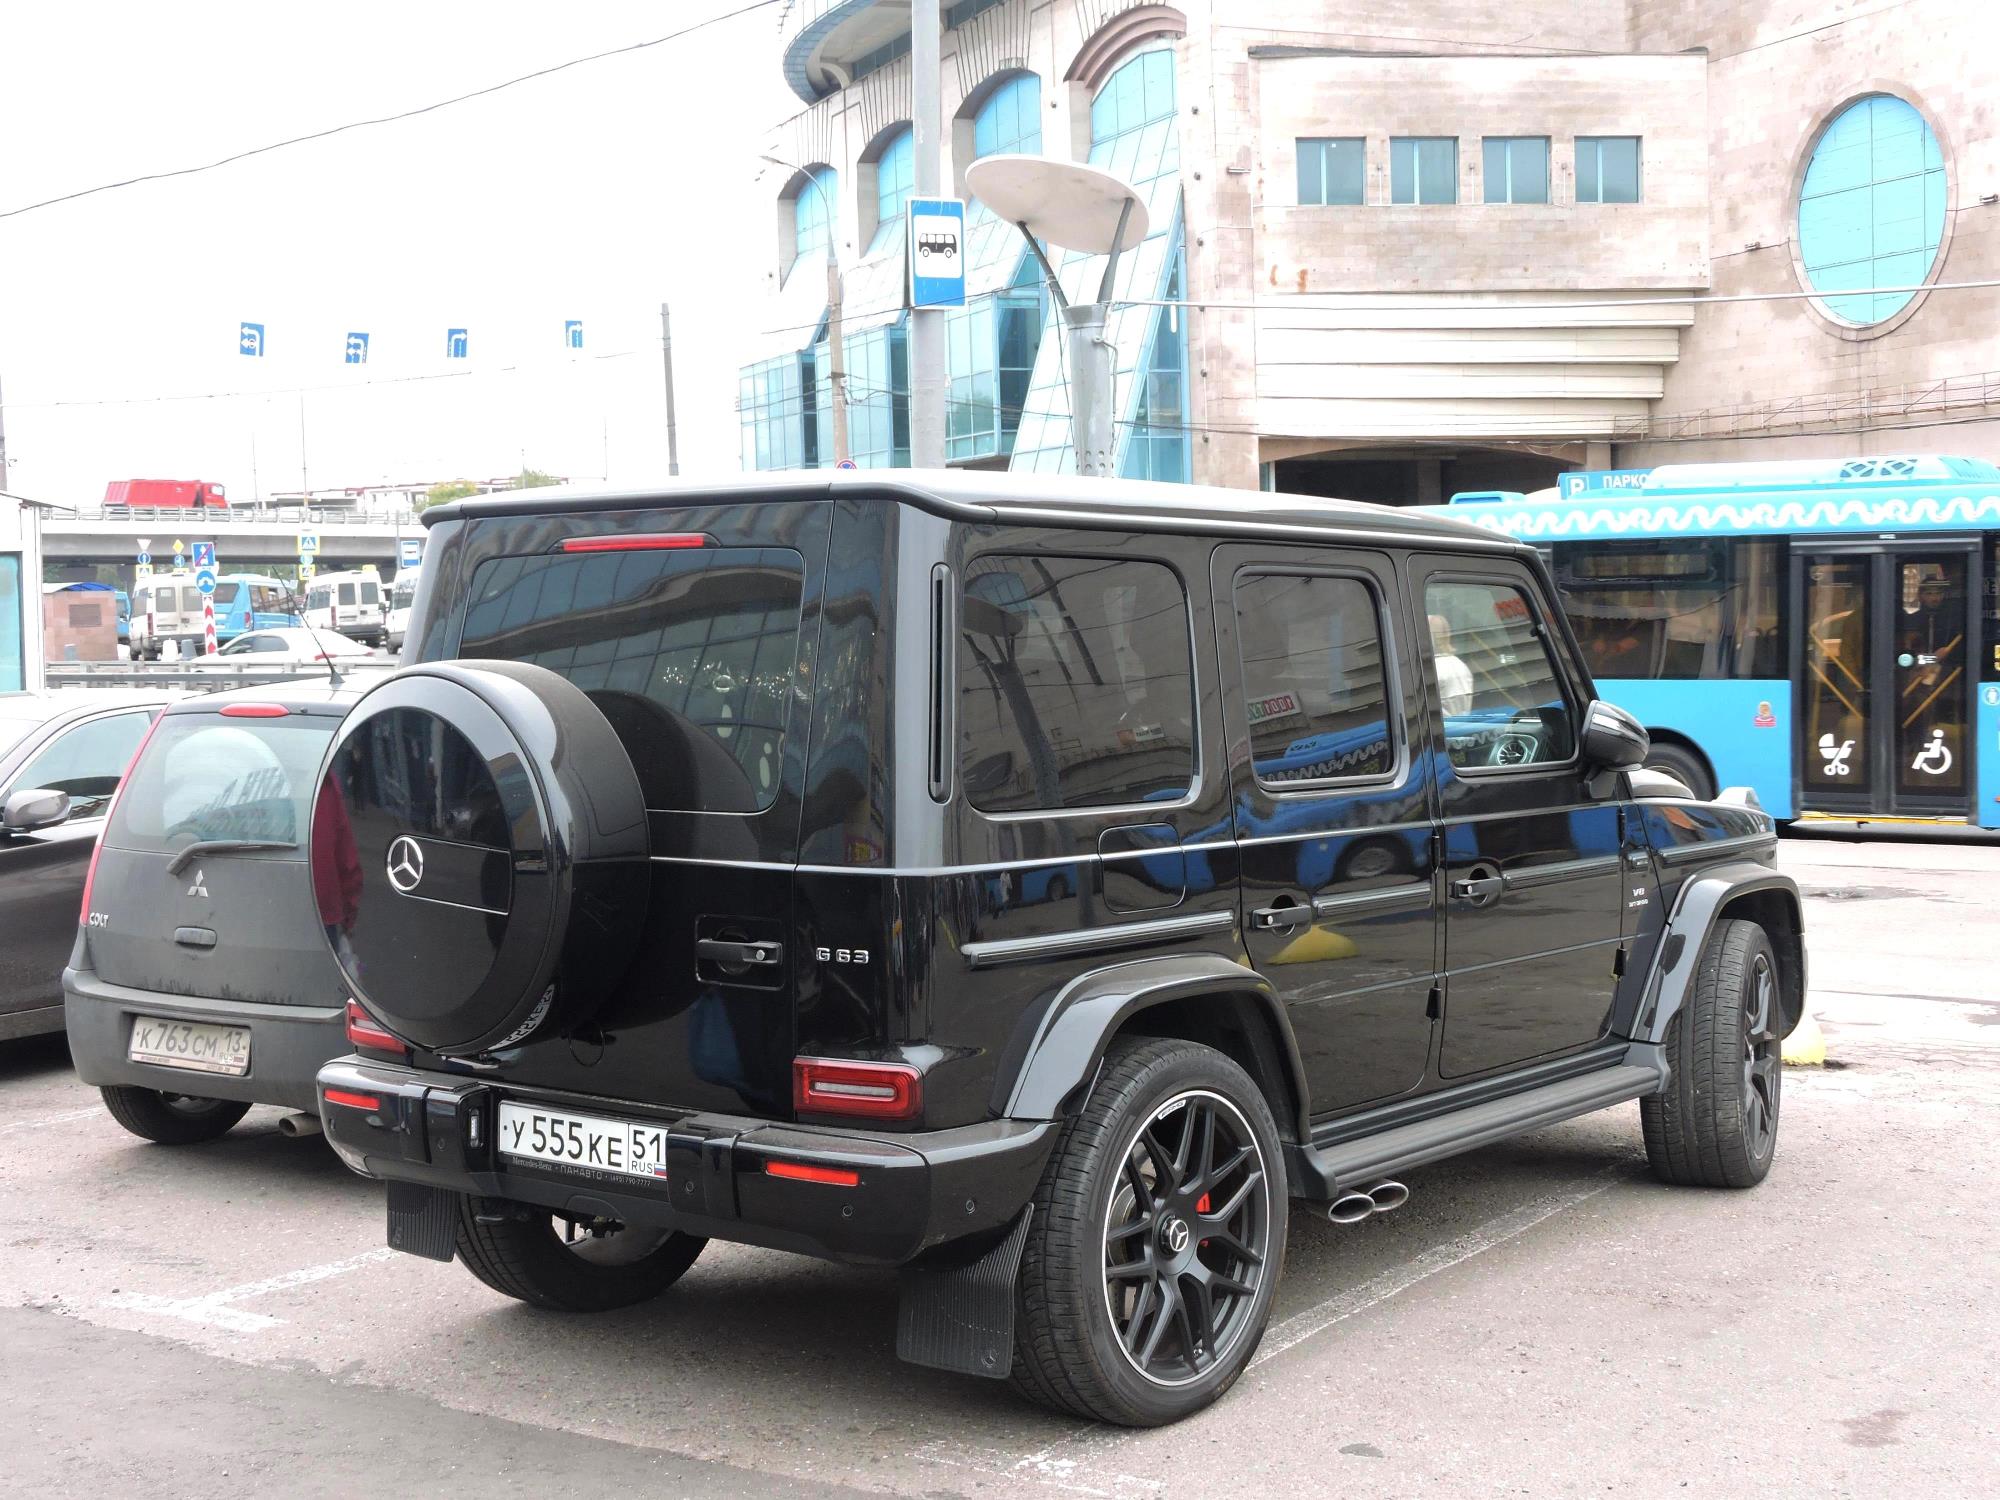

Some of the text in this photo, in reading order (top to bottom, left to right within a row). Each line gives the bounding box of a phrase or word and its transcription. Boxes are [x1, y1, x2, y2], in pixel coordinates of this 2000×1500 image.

[89, 912, 109, 928] COLT
[816, 947, 869, 964] G 63
[225, 1031, 243, 1053] 13
[512, 1115, 661, 1168] У555КЕ 51
[512, 1156, 553, 1172] Mercedes-Benz
[560, 1165, 603, 1180] ПАНАВТО
[631, 1160, 653, 1174] RUS
